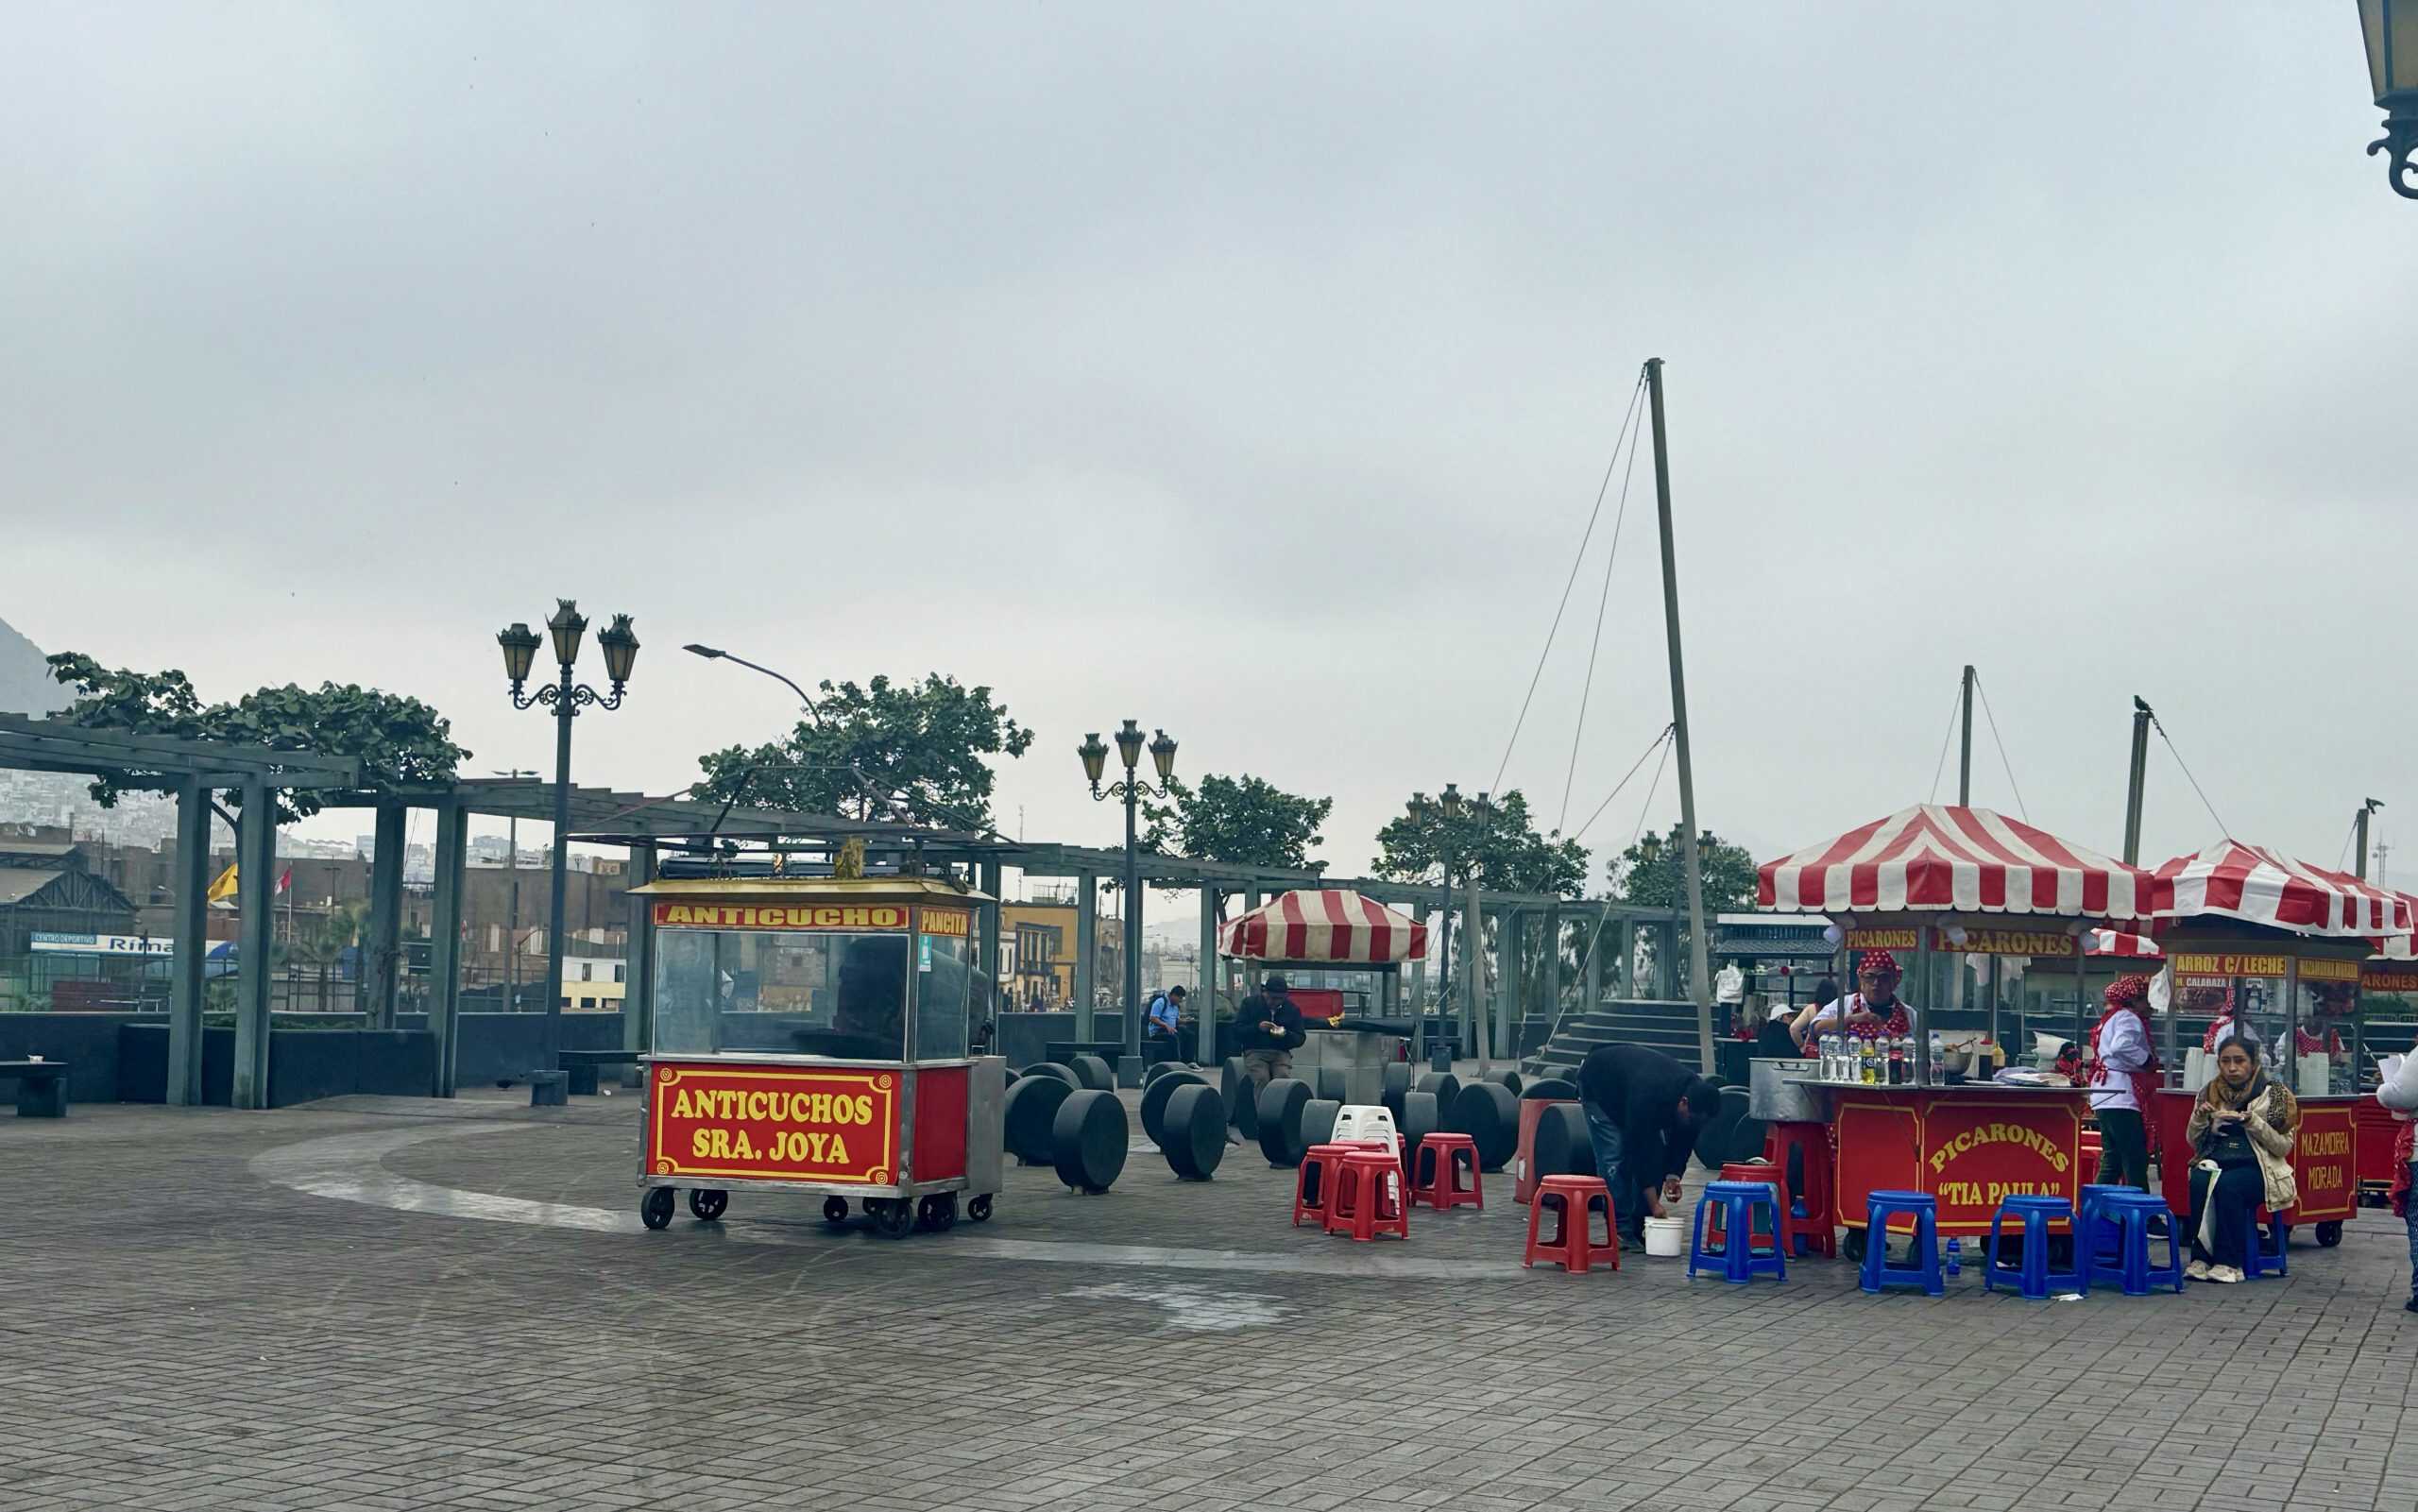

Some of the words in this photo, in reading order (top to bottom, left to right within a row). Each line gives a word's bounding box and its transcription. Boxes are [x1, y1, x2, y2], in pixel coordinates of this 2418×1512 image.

[667, 905, 897, 926] ANTICUCHO
[922, 910, 968, 934] PANCITA
[1847, 929, 1916, 948] PICARONES
[2176, 956, 2220, 973] ARROZ
[2224, 956, 2241, 974] C/
[2243, 957, 2285, 975] LECHE
[2186, 977, 2226, 988] CALABAZA
[671, 1089, 873, 1125] ANTICUCHOS
[692, 1128, 762, 1160] SRA.
[769, 1131, 850, 1164] JOYA
[1929, 1123, 2069, 1174] PICARONES
[2302, 1132, 2350, 1156] MAZAMORRA
[2308, 1164, 2343, 1191] MORADA
